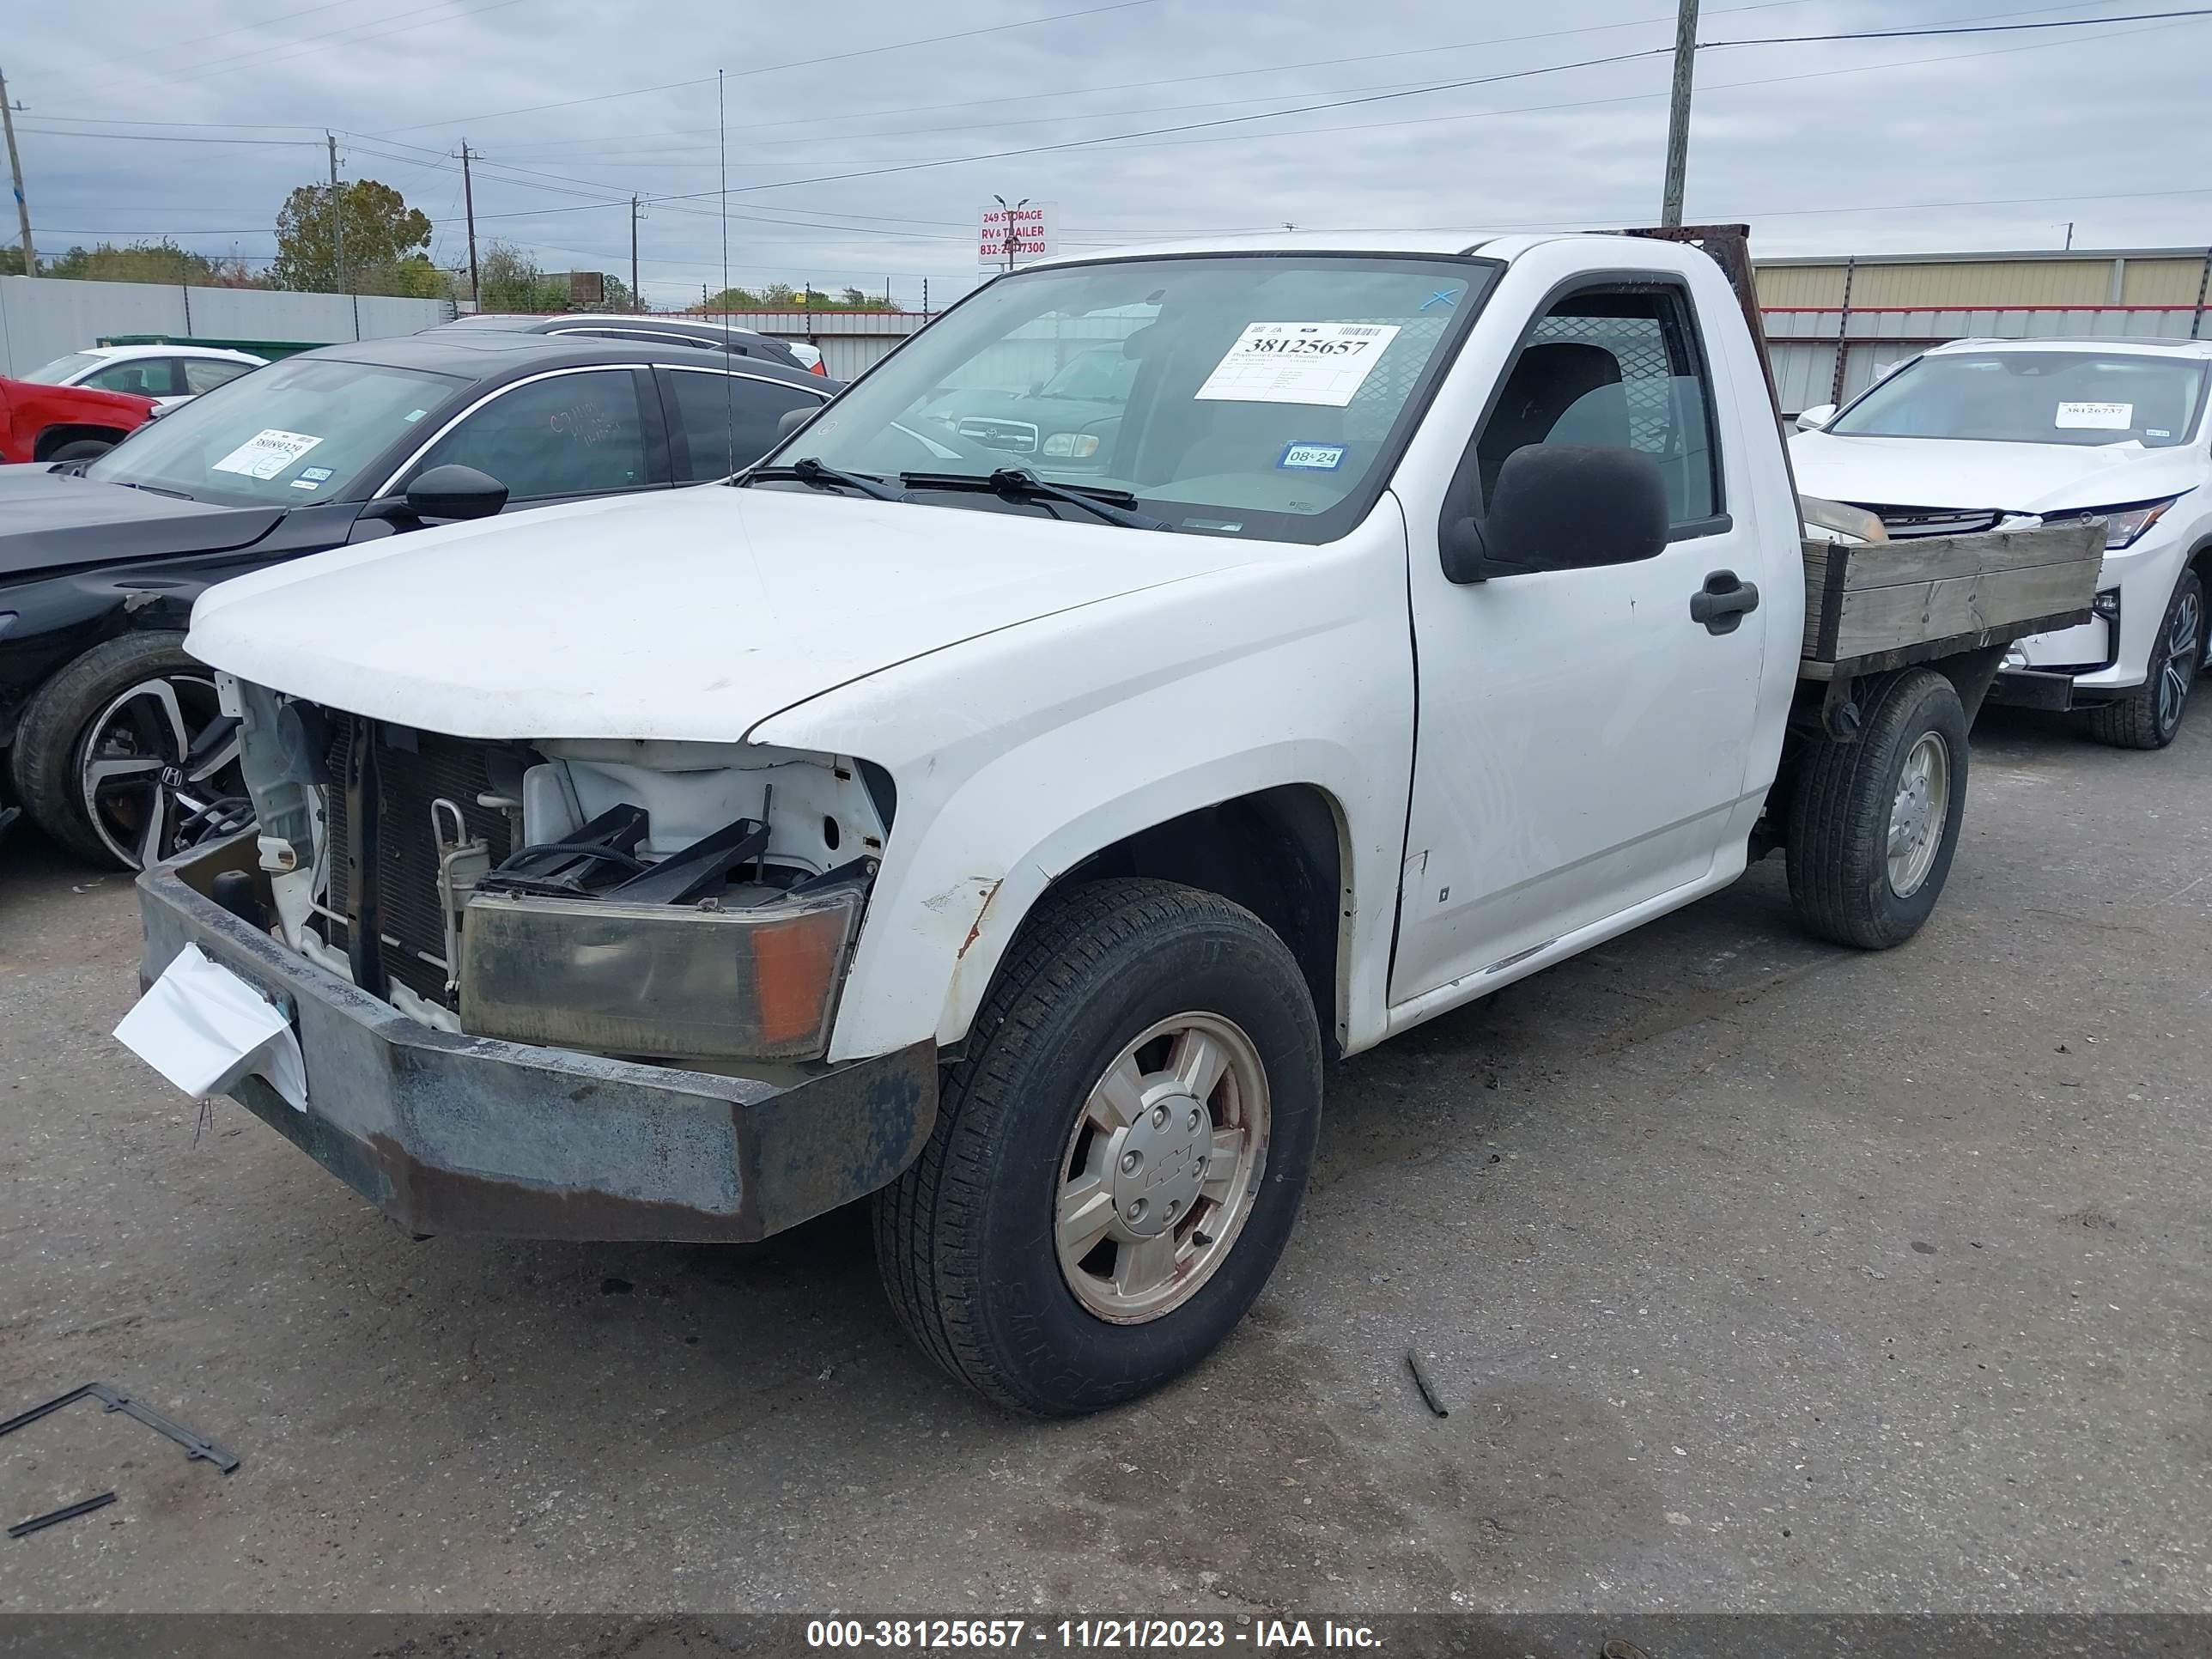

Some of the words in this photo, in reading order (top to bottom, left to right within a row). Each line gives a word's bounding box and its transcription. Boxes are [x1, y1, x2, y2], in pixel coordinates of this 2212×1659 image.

[983, 213, 999, 222] 249
[1001, 210, 1042, 222] STORAGE
[981, 228, 995, 239] RV
[1003, 226, 1044, 237] TAILER
[1245, 338, 1369, 356] 38125657
[1290, 451, 1310, 462] 08
[1316, 452, 1337, 463] 24
